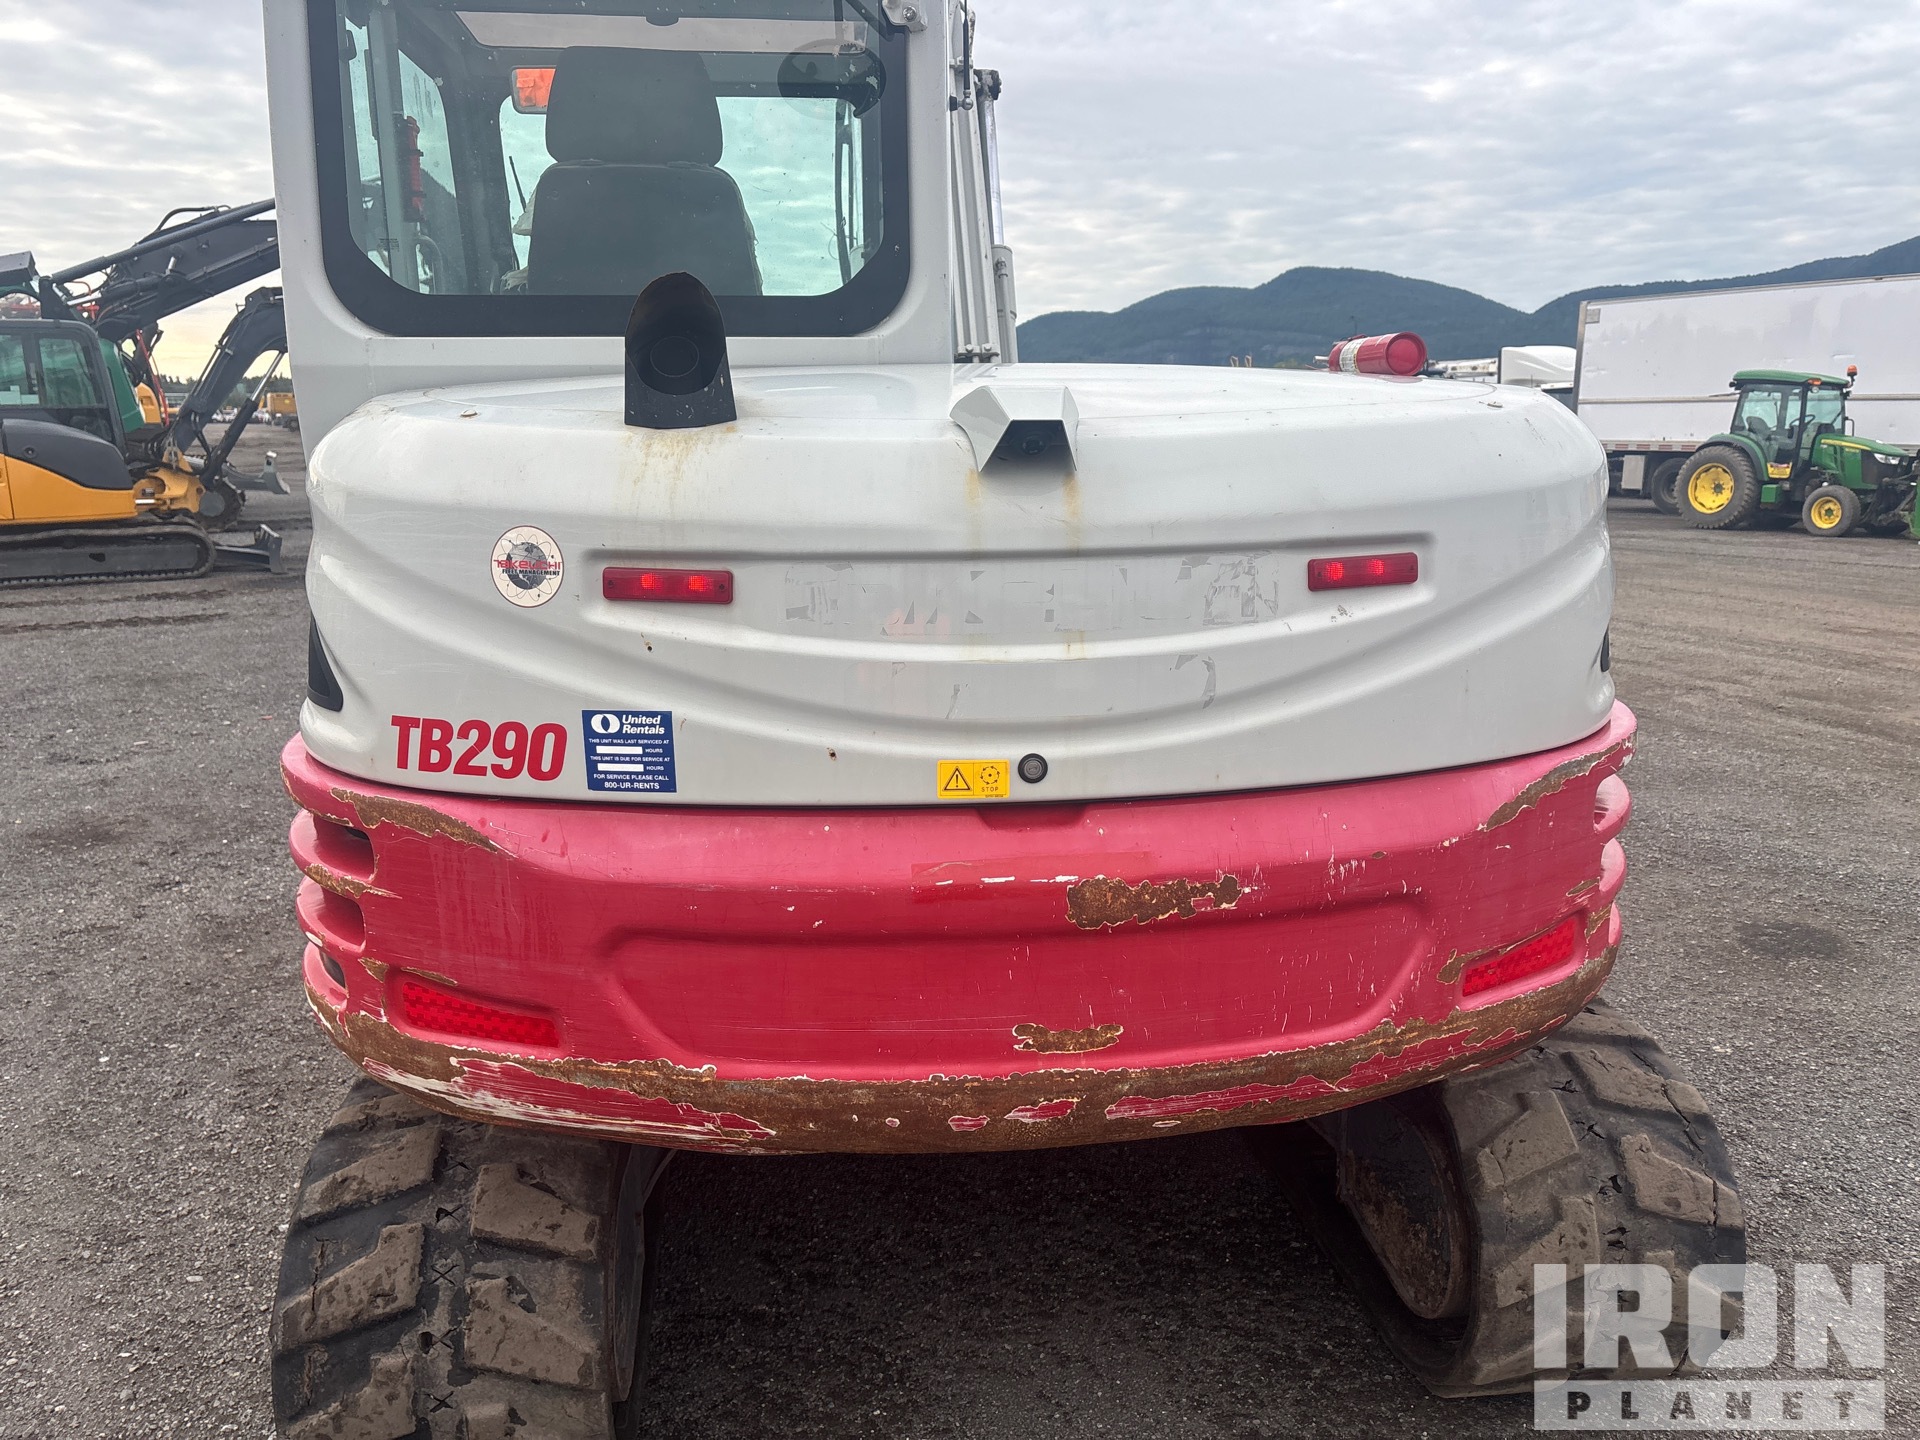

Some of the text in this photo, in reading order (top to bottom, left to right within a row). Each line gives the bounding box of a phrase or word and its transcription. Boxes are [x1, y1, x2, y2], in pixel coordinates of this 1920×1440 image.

[622, 714, 661, 725] United
[622, 724, 665, 735] Rentals
[391, 715, 568, 782] TB290
[604, 781, 660, 790] 800-UR-RENTS
